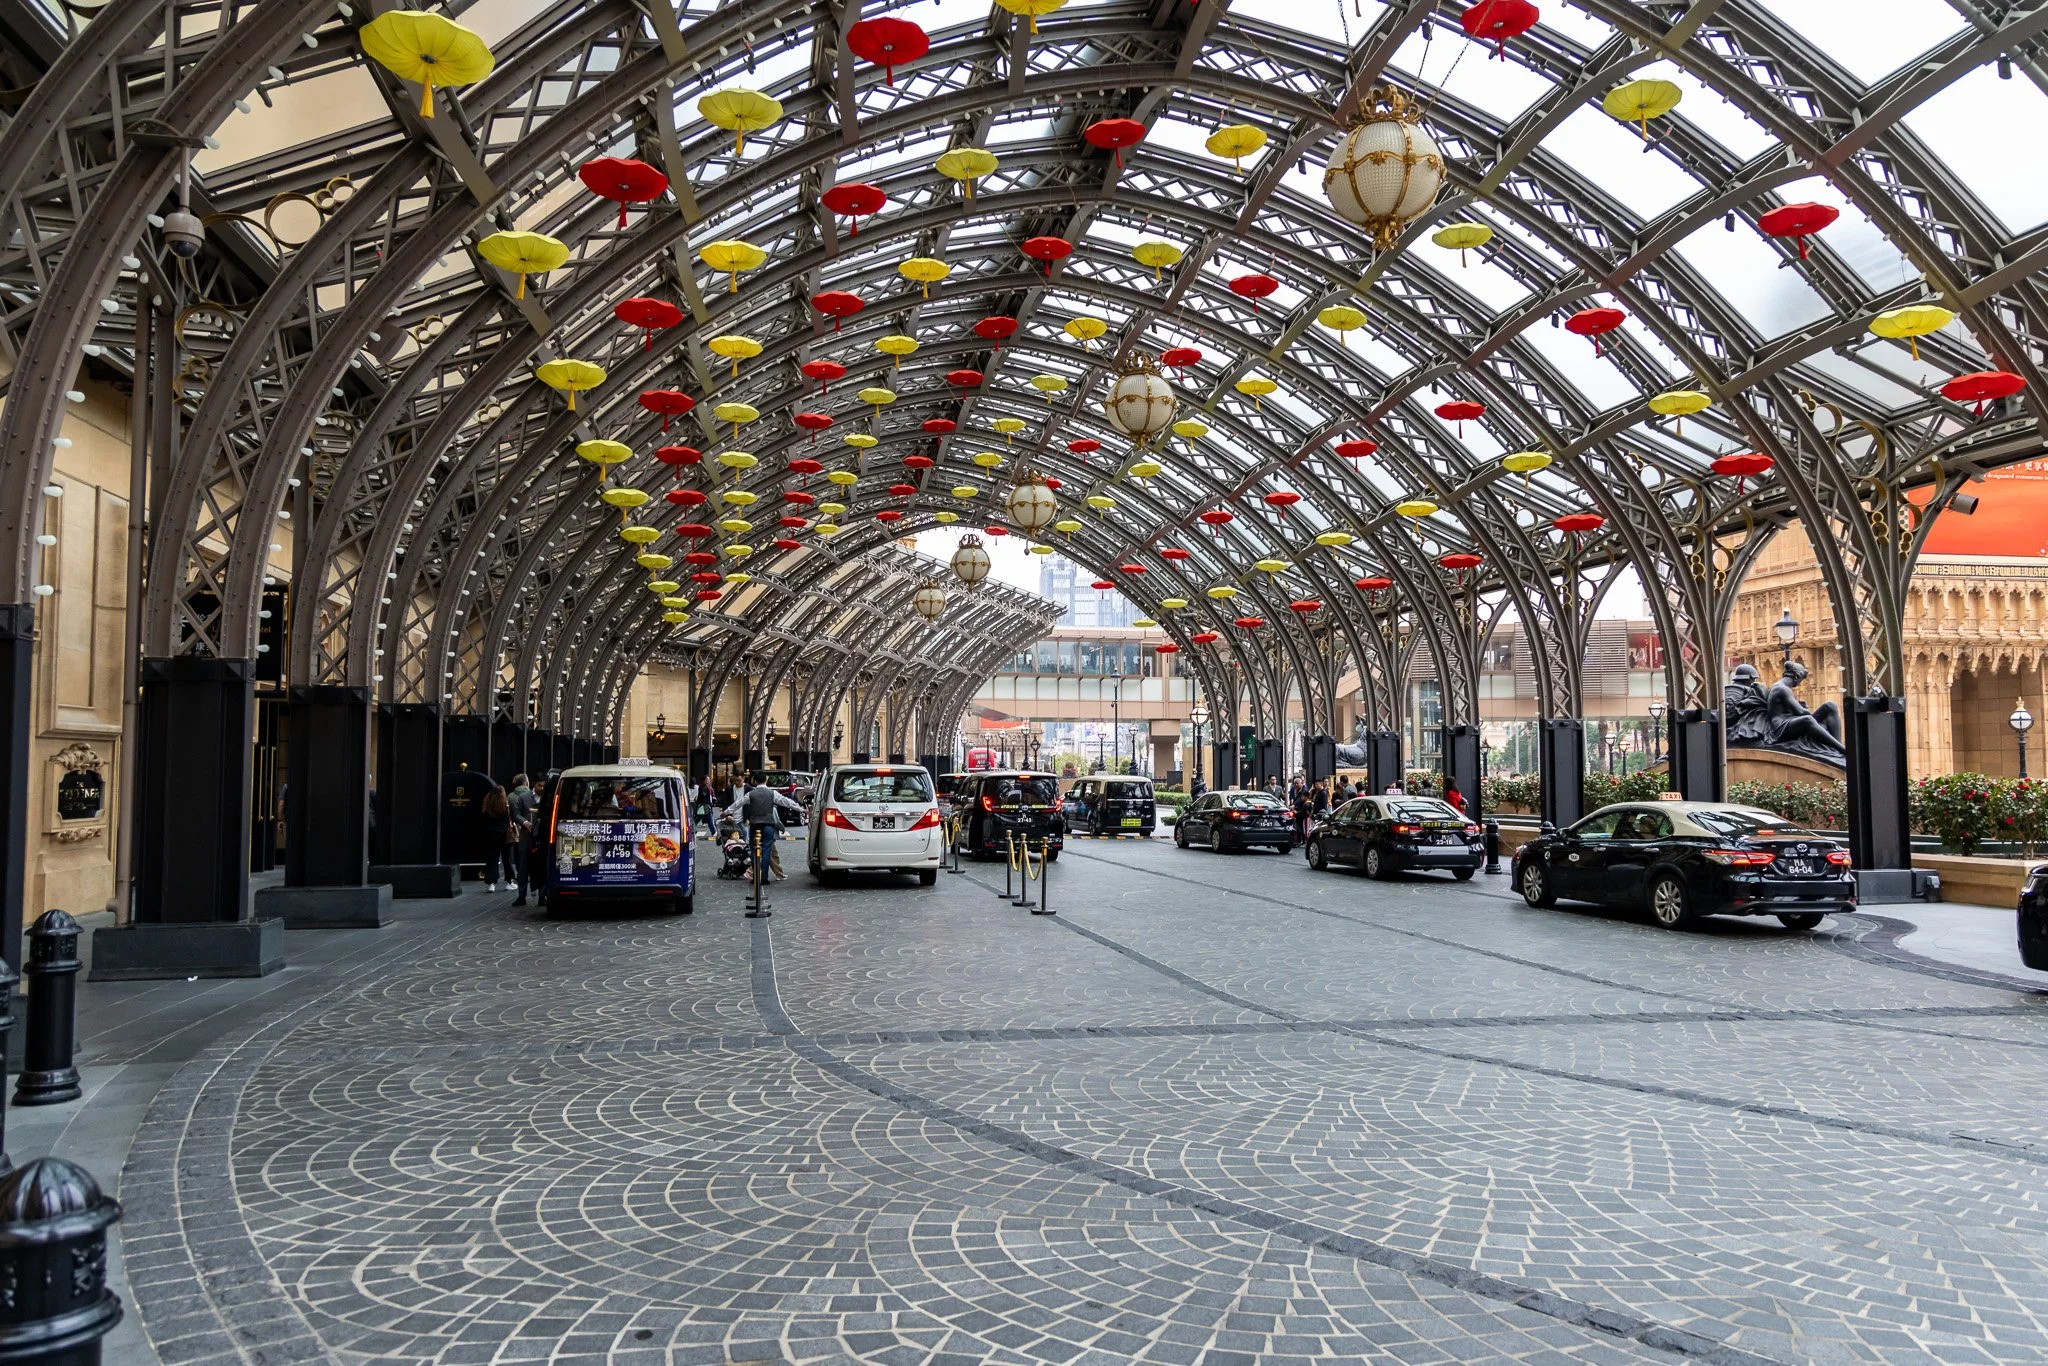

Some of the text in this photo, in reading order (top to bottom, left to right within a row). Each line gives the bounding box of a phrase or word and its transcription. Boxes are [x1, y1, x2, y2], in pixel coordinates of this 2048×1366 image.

[620, 758, 648, 766] TAXI
[564, 823, 613, 835] 珠海拱北
[613, 844, 625, 852] AC
[605, 850, 631, 859] 41-99
[1793, 858, 1805, 867] MA
[1788, 865, 1813, 875] 64-04
